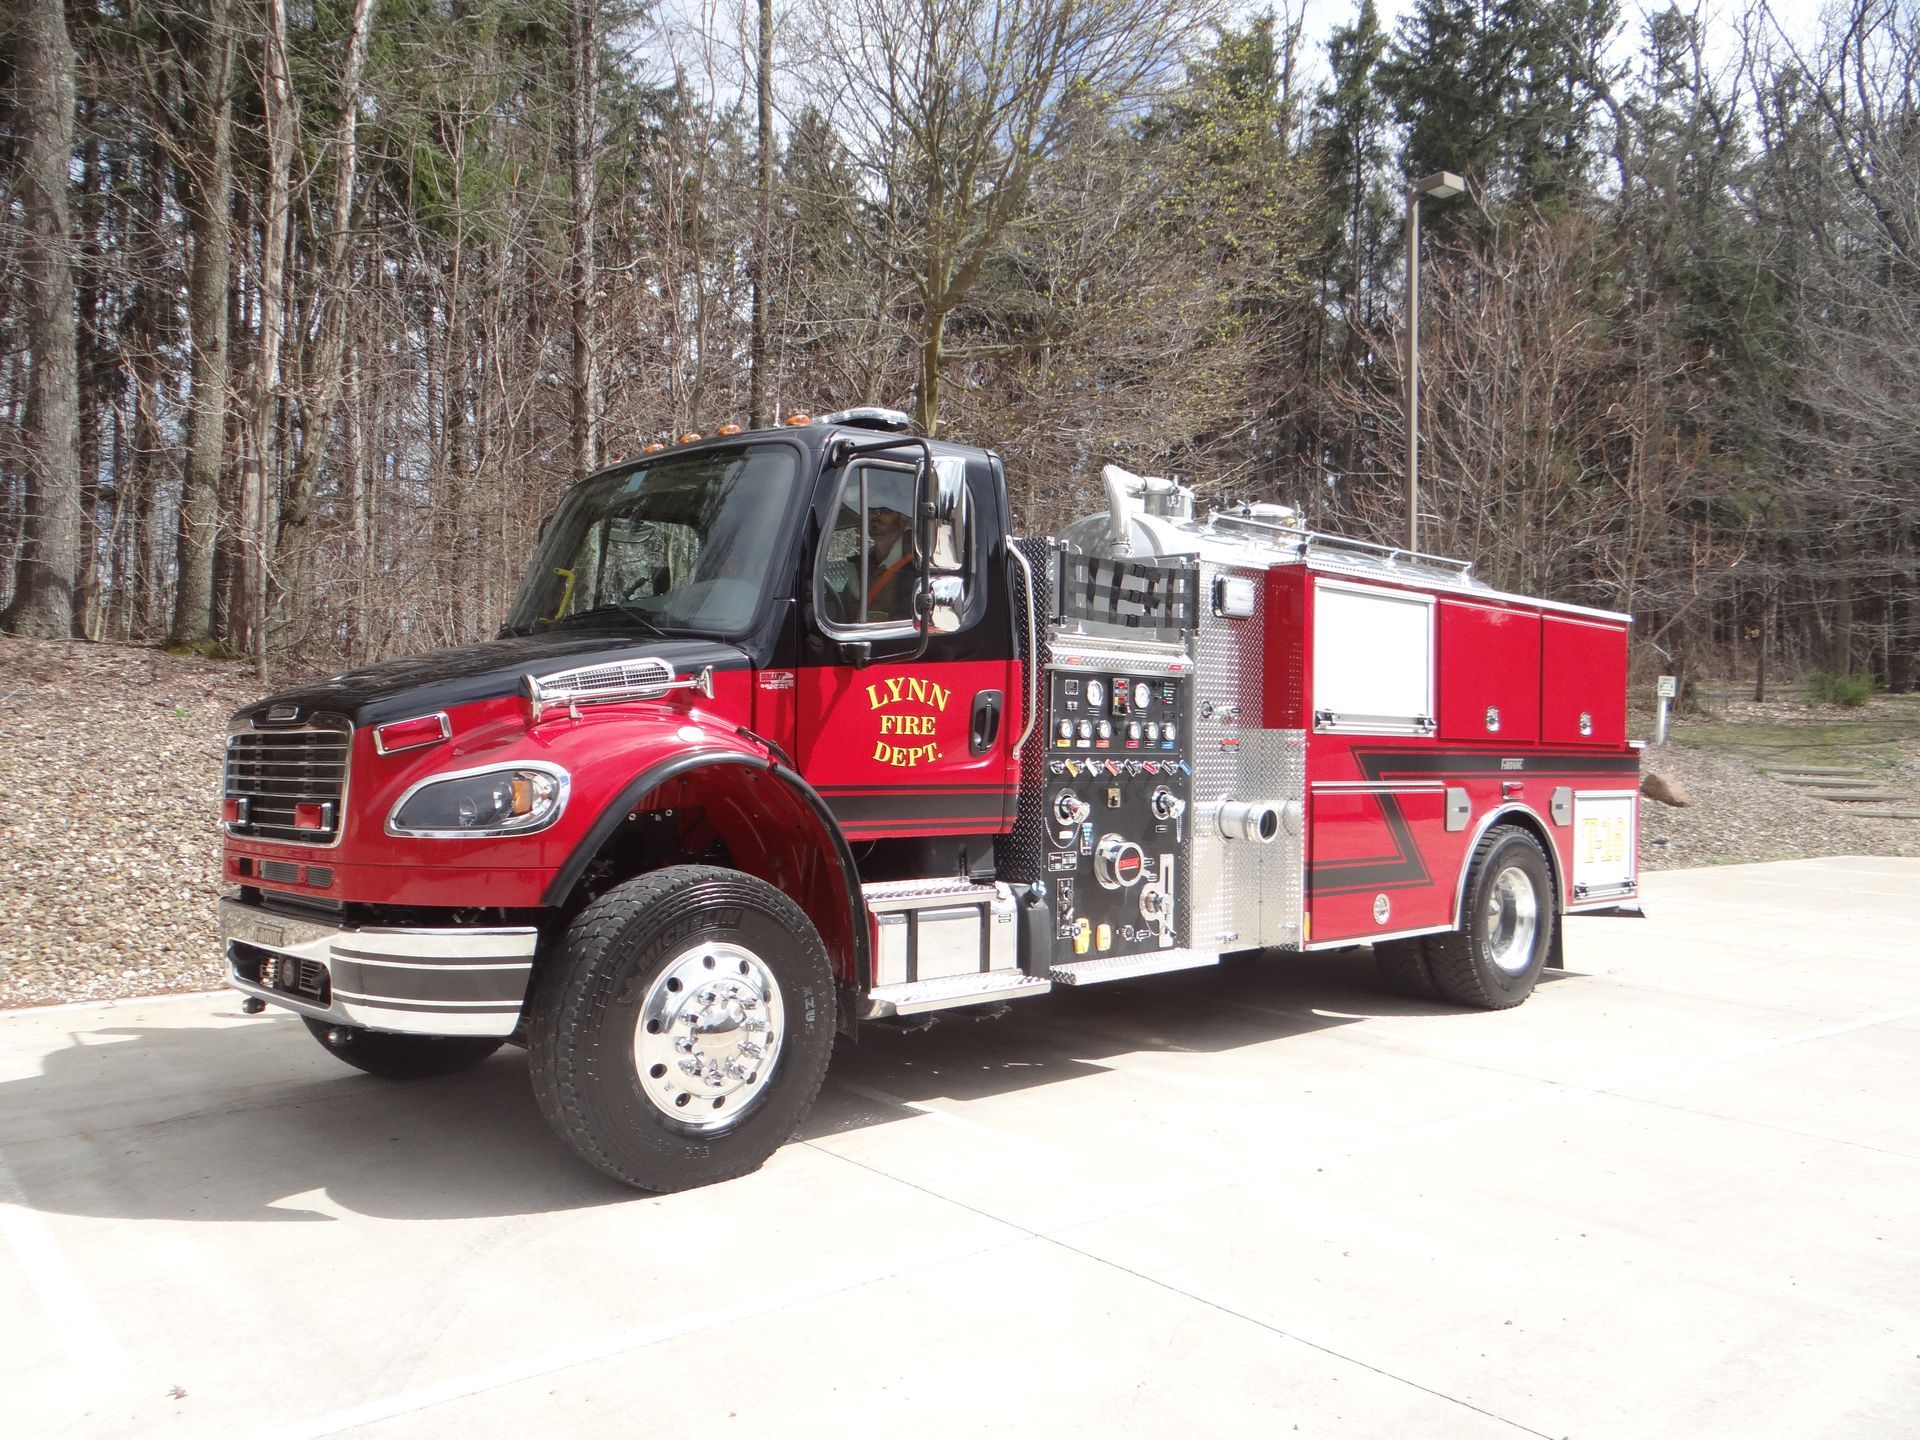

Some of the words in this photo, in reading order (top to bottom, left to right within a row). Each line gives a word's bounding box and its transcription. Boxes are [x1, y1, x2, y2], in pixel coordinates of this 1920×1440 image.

[866, 677, 951, 712] LYNN
[880, 715, 936, 735] FIRE
[872, 740, 943, 767] DEPT.
[638, 909, 743, 973] MICHELIN
